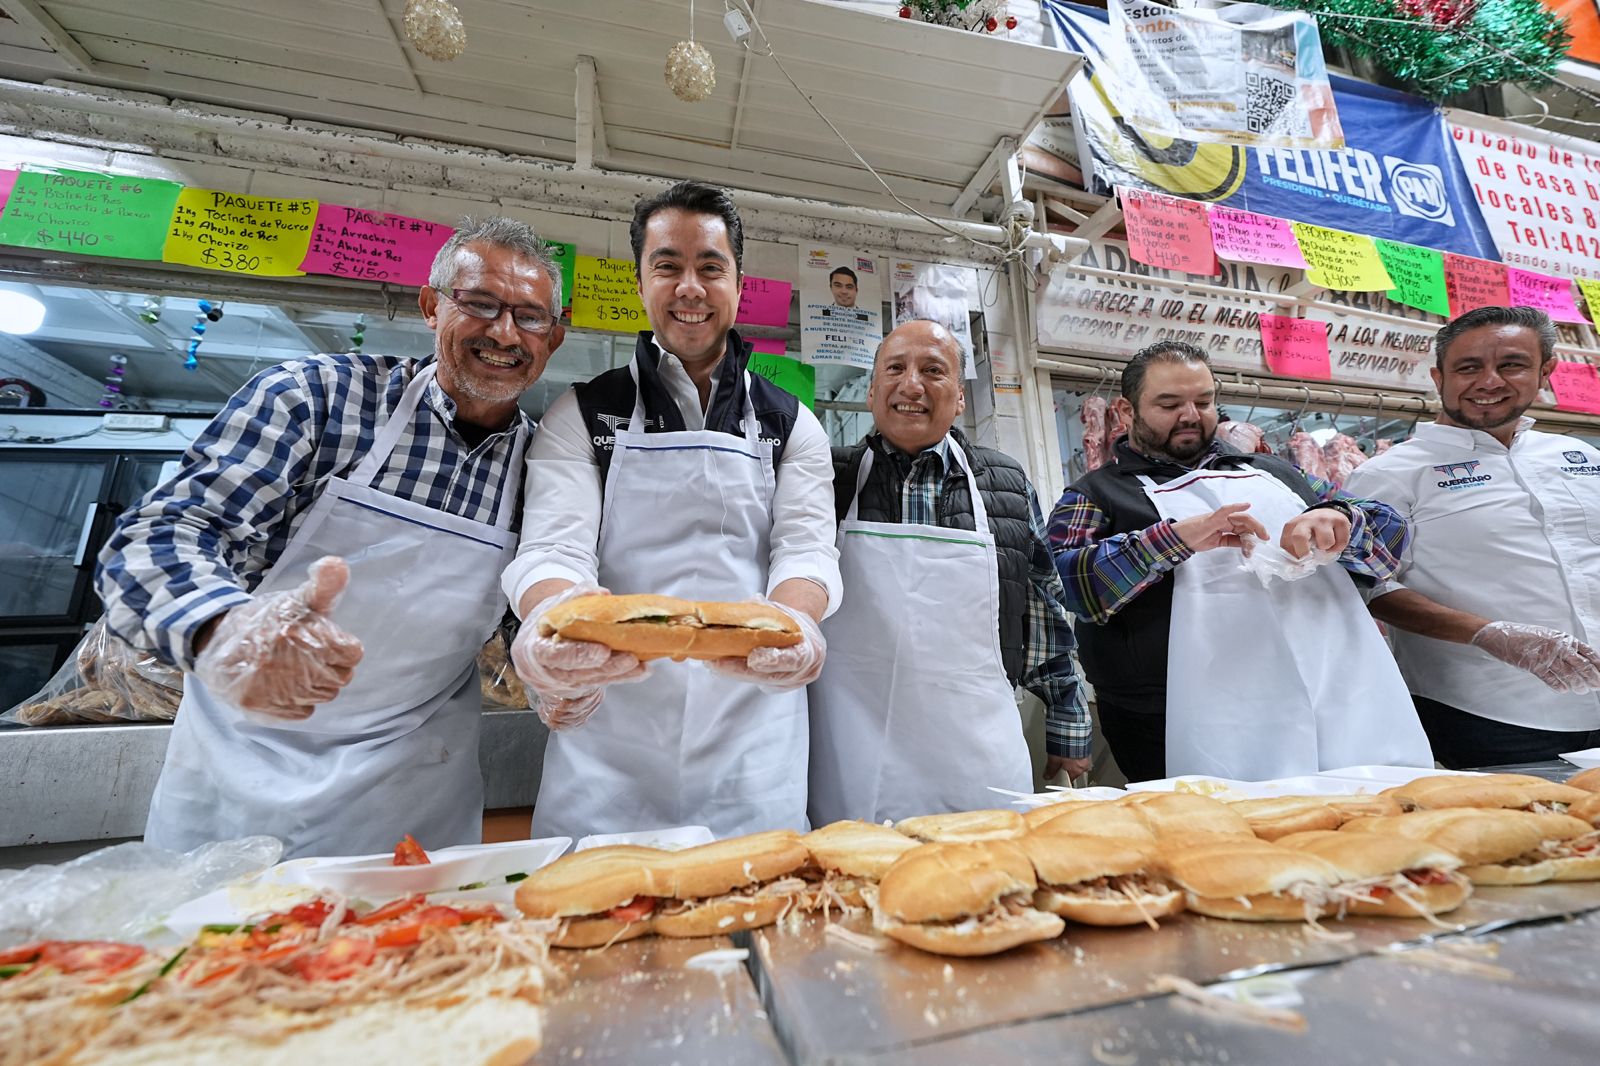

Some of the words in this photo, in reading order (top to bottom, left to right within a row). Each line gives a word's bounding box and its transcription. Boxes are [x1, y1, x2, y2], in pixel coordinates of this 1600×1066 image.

[1255, 146, 1388, 205] FELIFER
[1477, 155, 1506, 180] de
[1517, 164, 1577, 196] Casa
[211, 191, 284, 213] PAQUETE
[1262, 175, 1325, 199] PRESIDENTE
[1332, 192, 1393, 214] QUERÉTARO
[1397, 175, 1442, 208] PAN
[1474, 183, 1574, 224] locales
[1583, 207, 1600, 230] 8
[204, 207, 258, 227] Tocineta
[260, 219, 273, 230] de
[197, 233, 250, 251] Chorizo
[240, 227, 255, 240] de
[256, 229, 280, 243] Res
[1501, 249, 1549, 269] sando
[1553, 261, 1562, 272] a
[1567, 262, 1588, 277] los
[1078, 288, 1139, 314] OFRECE
[1141, 297, 1155, 319] A
[1159, 298, 1182, 321] UD.
[1187, 302, 1208, 324] EL
[1214, 306, 1261, 332] MEJO
[1335, 323, 1349, 343] A
[1353, 326, 1380, 347] LOS
[1380, 330, 1437, 354] MEJORES
[825, 334, 866, 346] FELIER
[1054, 314, 1124, 340] PRECIOS
[1123, 323, 1150, 343] EN
[1208, 332, 1230, 351] DE
[1233, 335, 1264, 358] CER
[1338, 351, 1420, 377] DERIVADOS
[1437, 474, 1492, 489] QUERÉTARO
